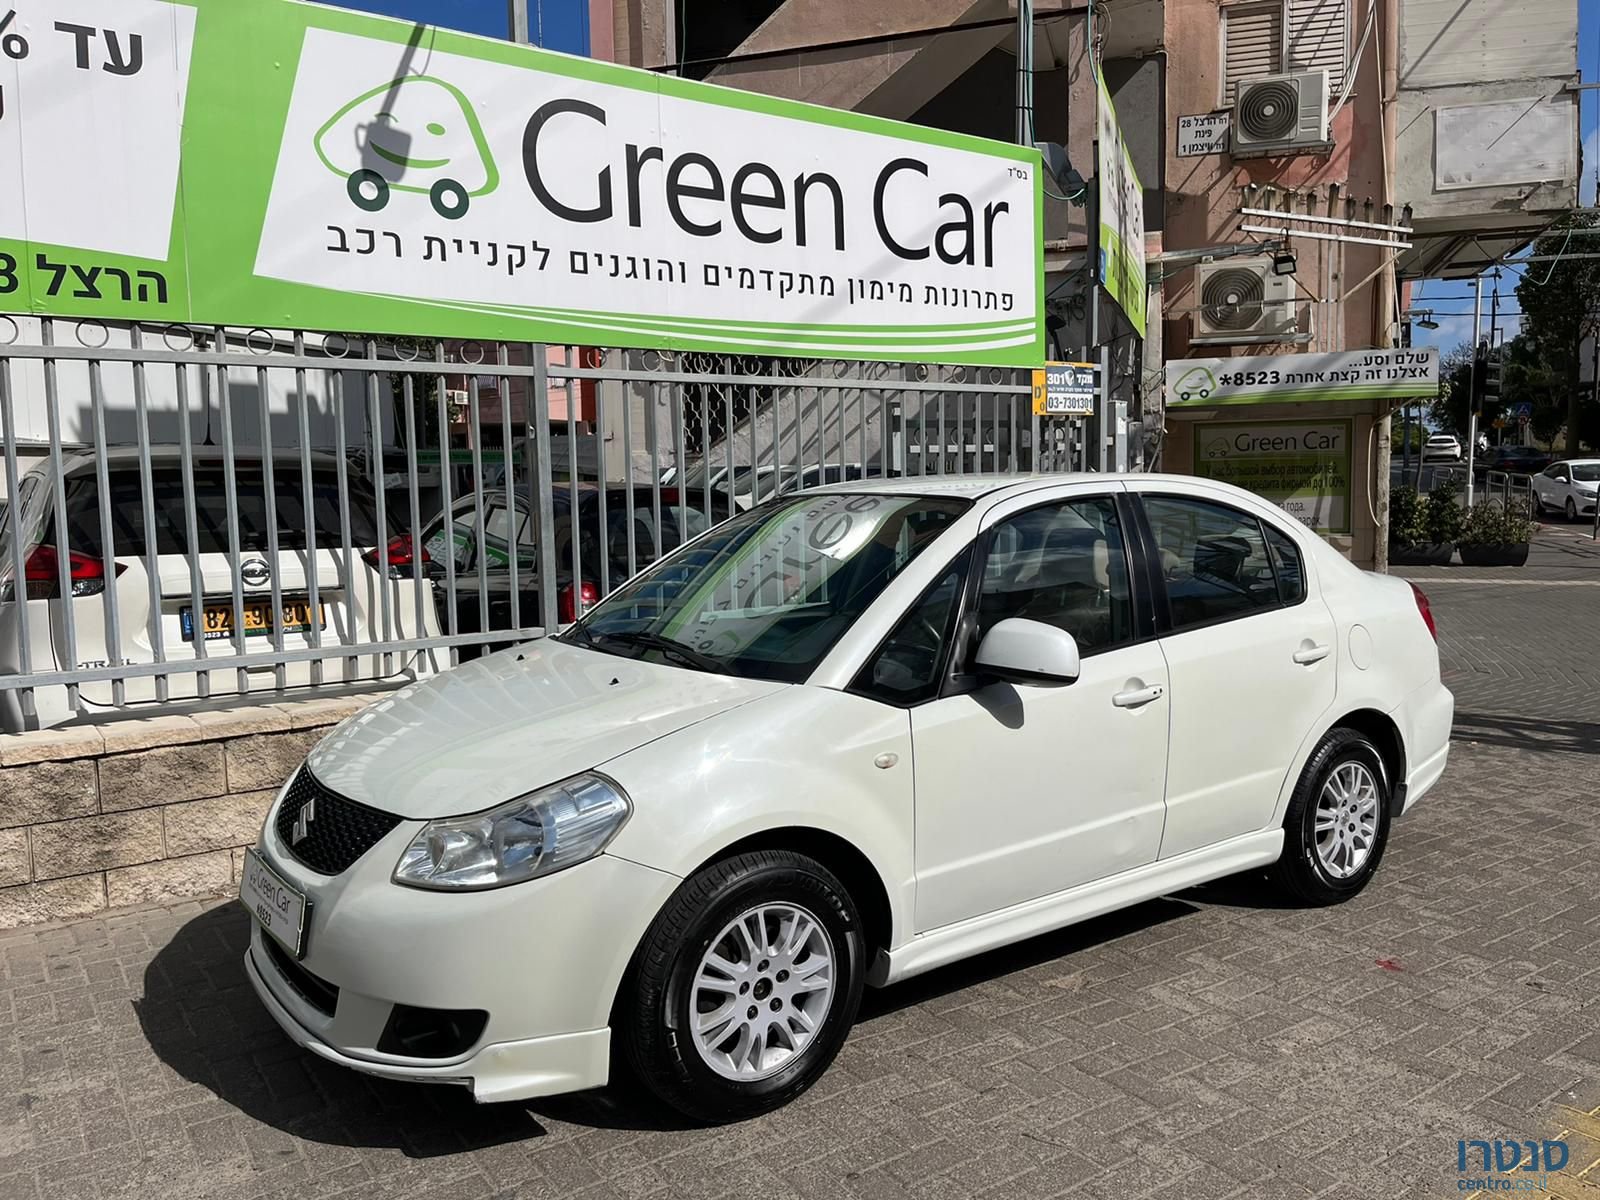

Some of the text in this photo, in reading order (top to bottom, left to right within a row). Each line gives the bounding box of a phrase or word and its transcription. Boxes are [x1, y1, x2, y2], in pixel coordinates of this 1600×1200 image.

[54, 21, 143, 76] עד
[1181, 119, 1192, 128] 28
[1194, 116, 1216, 127] הרצל
[1194, 129, 1213, 139] פינת
[1182, 145, 1187, 153] 1
[1007, 167, 1028, 180] בס"ד
[523, 98, 845, 251] Green
[873, 157, 1009, 268] Car
[327, 225, 1013, 312] פתרונות מימון מתקדמים והוגנים לקניית רכב
[36, 253, 168, 304] הרצל
[1395, 352, 1430, 365] שלם
[1047, 373, 1065, 385] 301
[1285, 372, 1324, 384] אחרת
[1329, 370, 1360, 384] קצת
[1365, 369, 1382, 380] זה
[1386, 366, 1429, 379] אצלנו
[1048, 396, 1093, 409] 03-7301301
[1234, 431, 1340, 451] Green Car
[257, 868, 291, 914] Green Car
